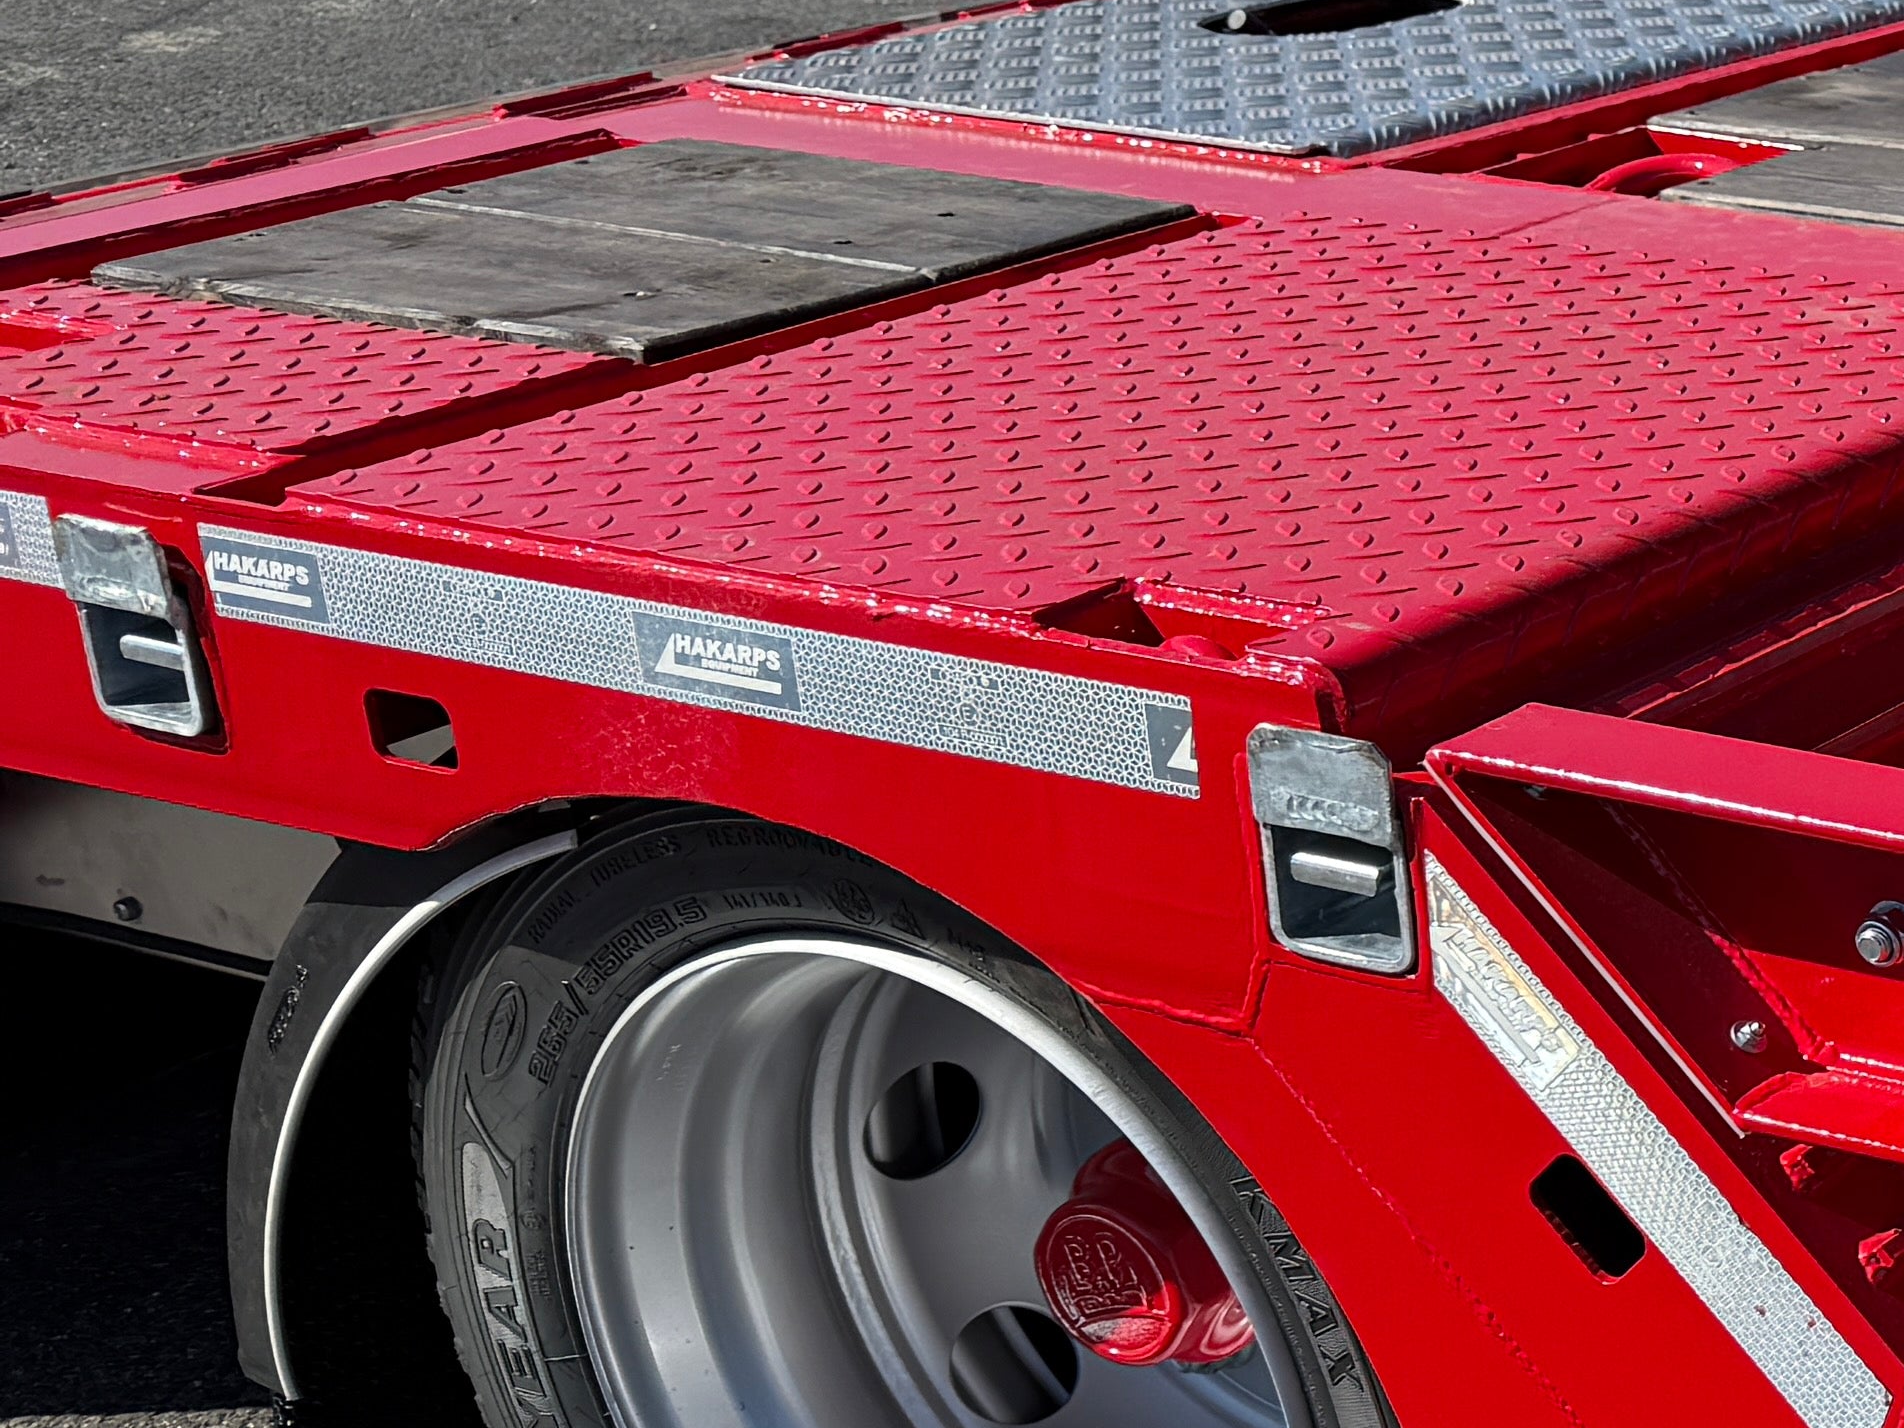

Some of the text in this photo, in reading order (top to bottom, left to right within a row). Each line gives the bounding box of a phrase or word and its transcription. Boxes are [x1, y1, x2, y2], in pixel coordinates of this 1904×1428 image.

[213, 551, 309, 586] HAKARPS
[675, 633, 781, 671] HAKARPS
[701, 658, 759, 677] EQUIPMENT
[1229, 1175, 1365, 1394] KMAX
